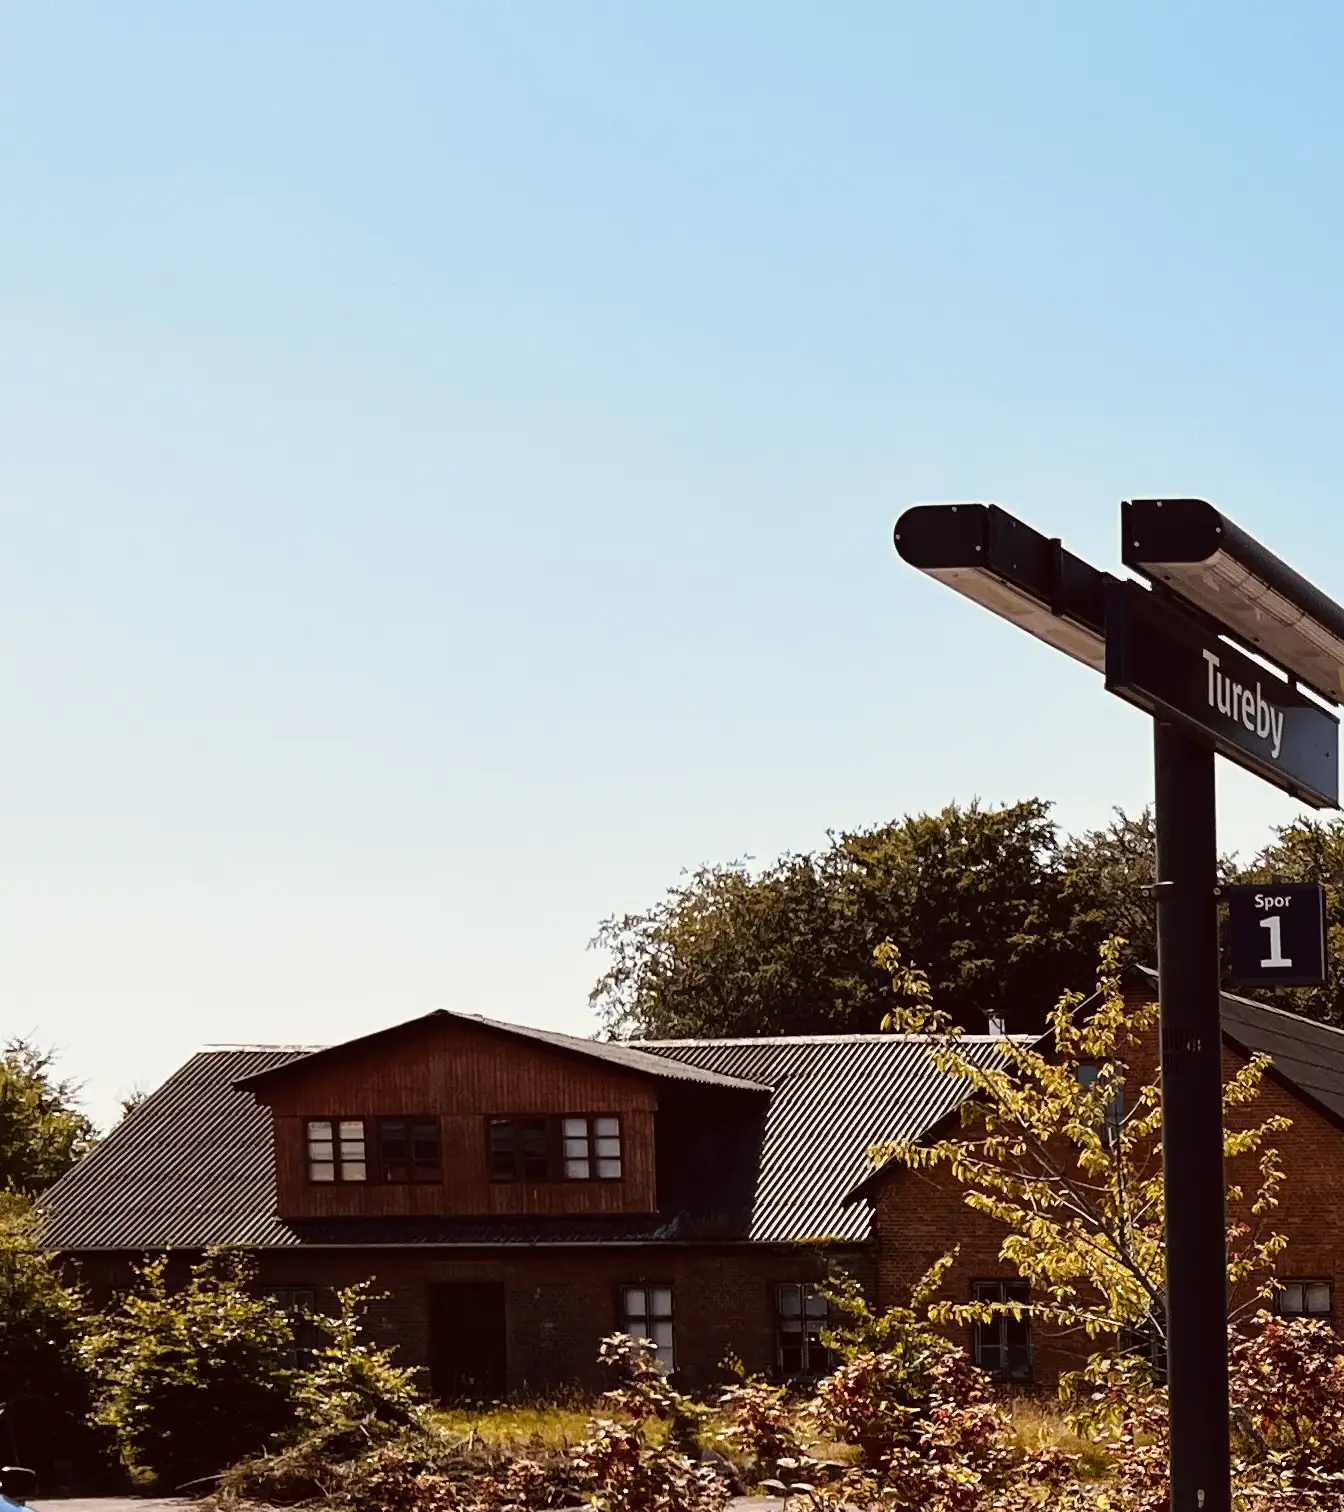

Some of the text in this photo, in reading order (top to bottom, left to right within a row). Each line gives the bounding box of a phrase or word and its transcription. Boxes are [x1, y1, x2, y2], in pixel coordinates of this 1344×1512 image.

[1202, 648, 1284, 759] Tureby
[1254, 893, 1292, 911] Spor
[1259, 915, 1293, 968] 1
